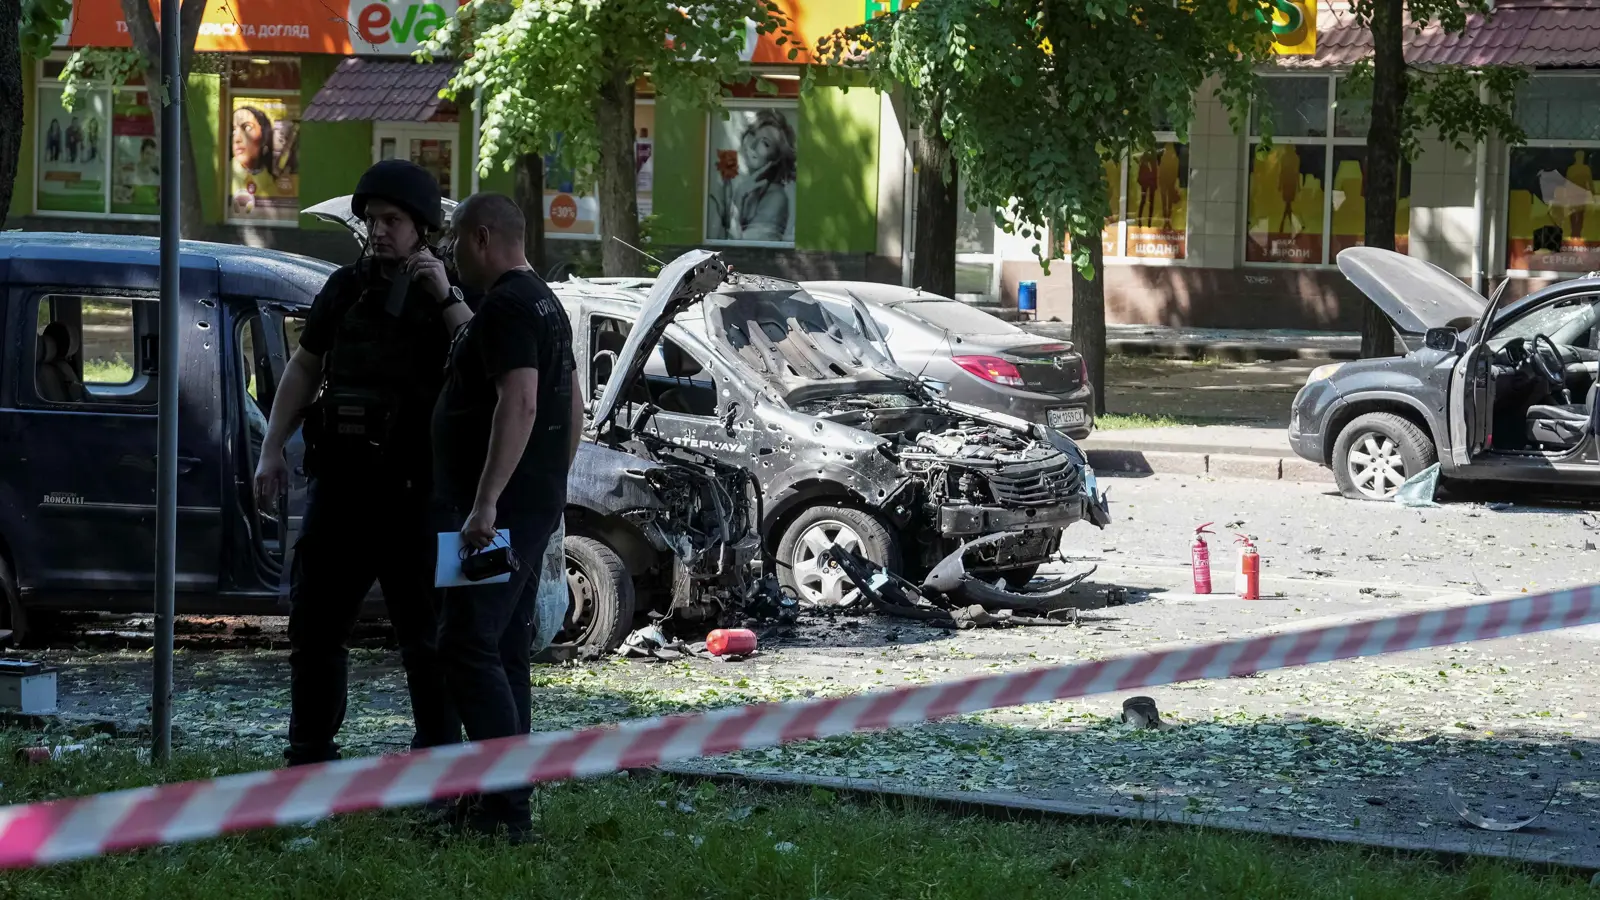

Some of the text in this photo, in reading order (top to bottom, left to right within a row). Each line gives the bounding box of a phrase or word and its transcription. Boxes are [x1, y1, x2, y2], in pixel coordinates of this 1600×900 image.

[358, 3, 446, 44] eva
[242, 25, 256, 36] ТА
[258, 24, 310, 38] ДОГЛЯД
[1542, 255, 1584, 265] СЕРЕДА
[672, 437, 739, 452] STEPWAY
[44, 494, 84, 504] RONCALLI
